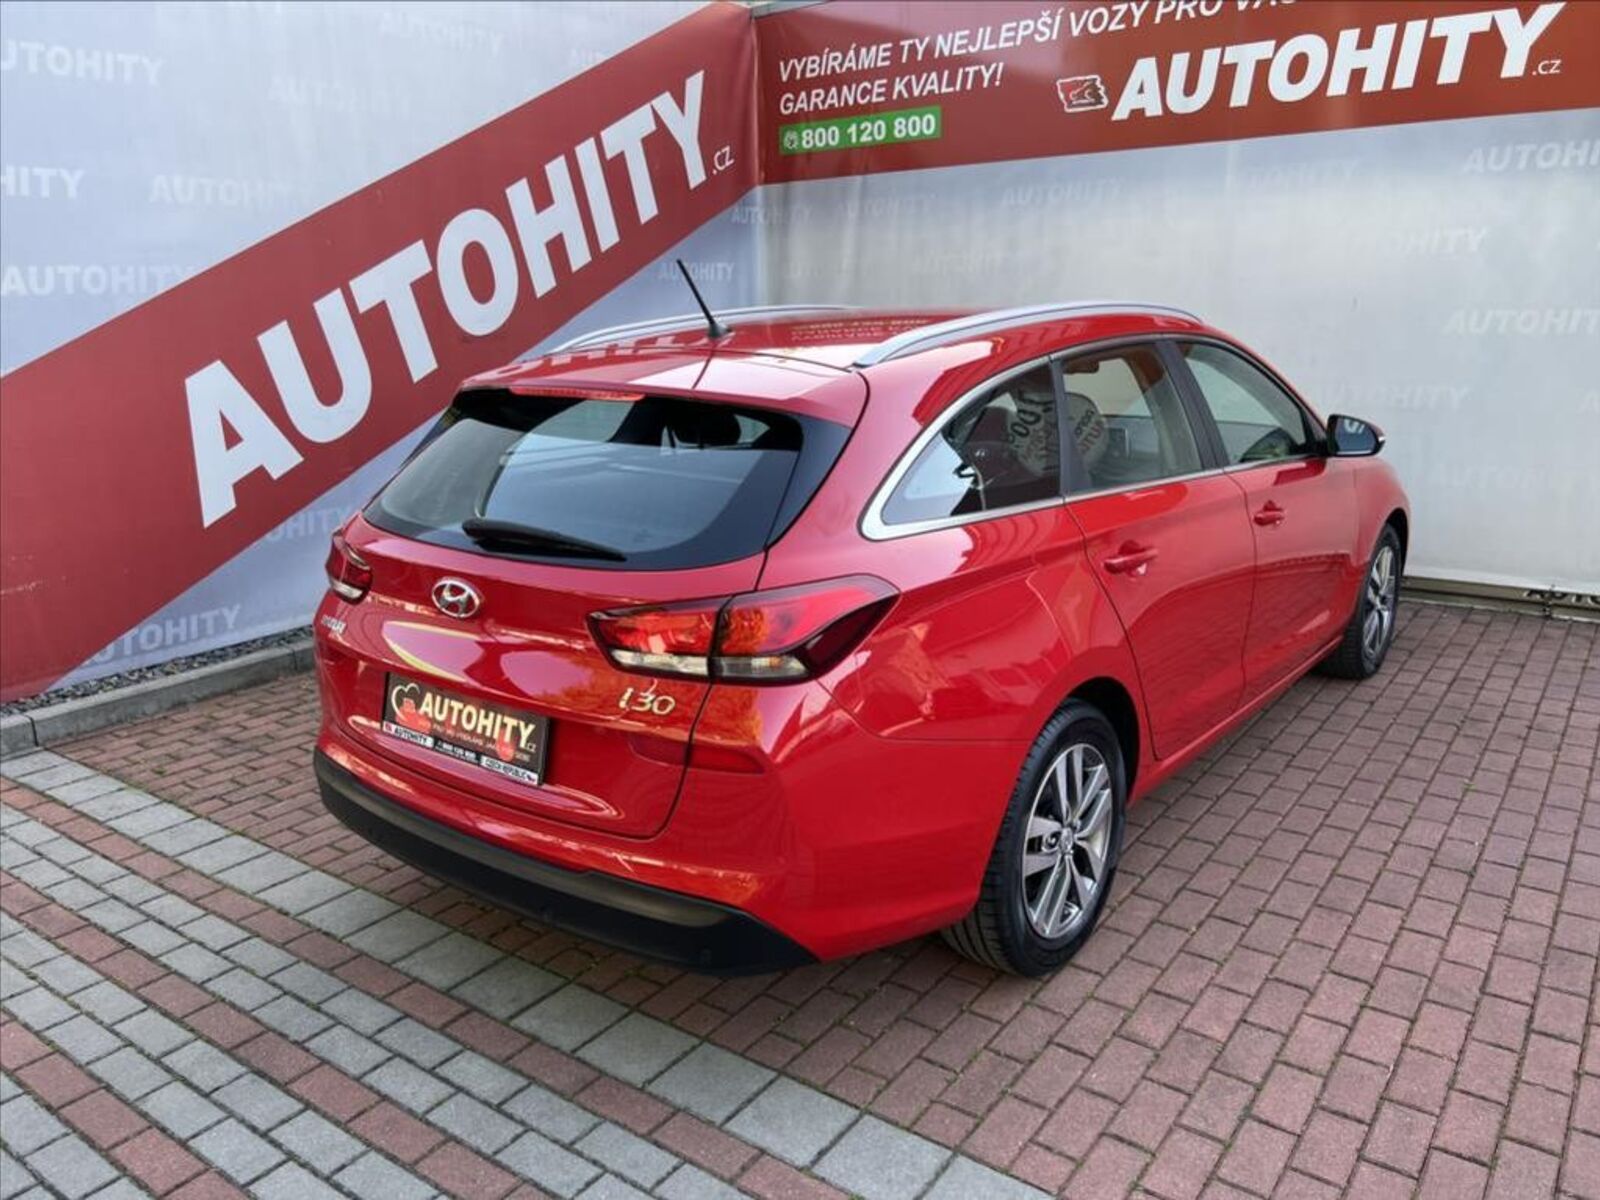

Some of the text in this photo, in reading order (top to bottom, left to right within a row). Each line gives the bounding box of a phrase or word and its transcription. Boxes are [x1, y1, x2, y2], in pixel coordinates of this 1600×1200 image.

[779, 43, 892, 82] VYBÍRÁME
[899, 37, 929, 64] TY
[934, 10, 1063, 58] NEJLEPŠÍ
[1069, 0, 1148, 37] VOZY
[779, 62, 1004, 116] GARANCE KVALITY!
[801, 113, 936, 150] 800 120 800
[418, 691, 537, 749] AUTOHITY
